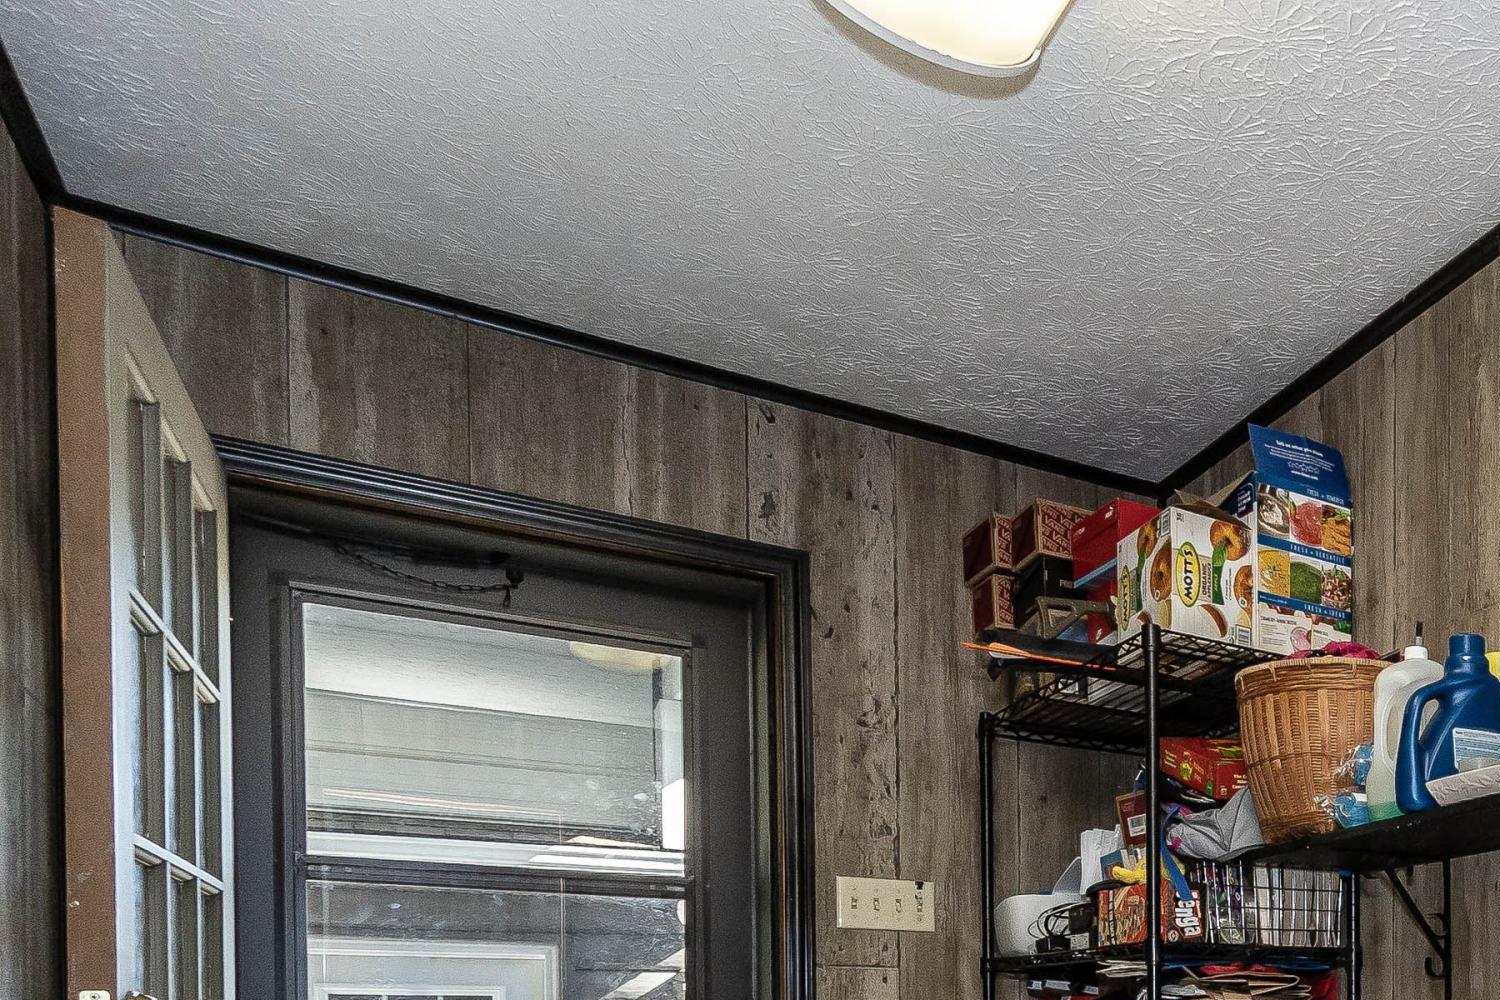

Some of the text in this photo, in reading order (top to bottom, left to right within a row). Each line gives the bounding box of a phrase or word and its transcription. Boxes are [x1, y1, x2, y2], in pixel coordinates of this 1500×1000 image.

[1290, 543, 1308, 556] FRESH
[1182, 548, 1193, 600] MOTT'S
[1304, 603, 1321, 614] FRESH
